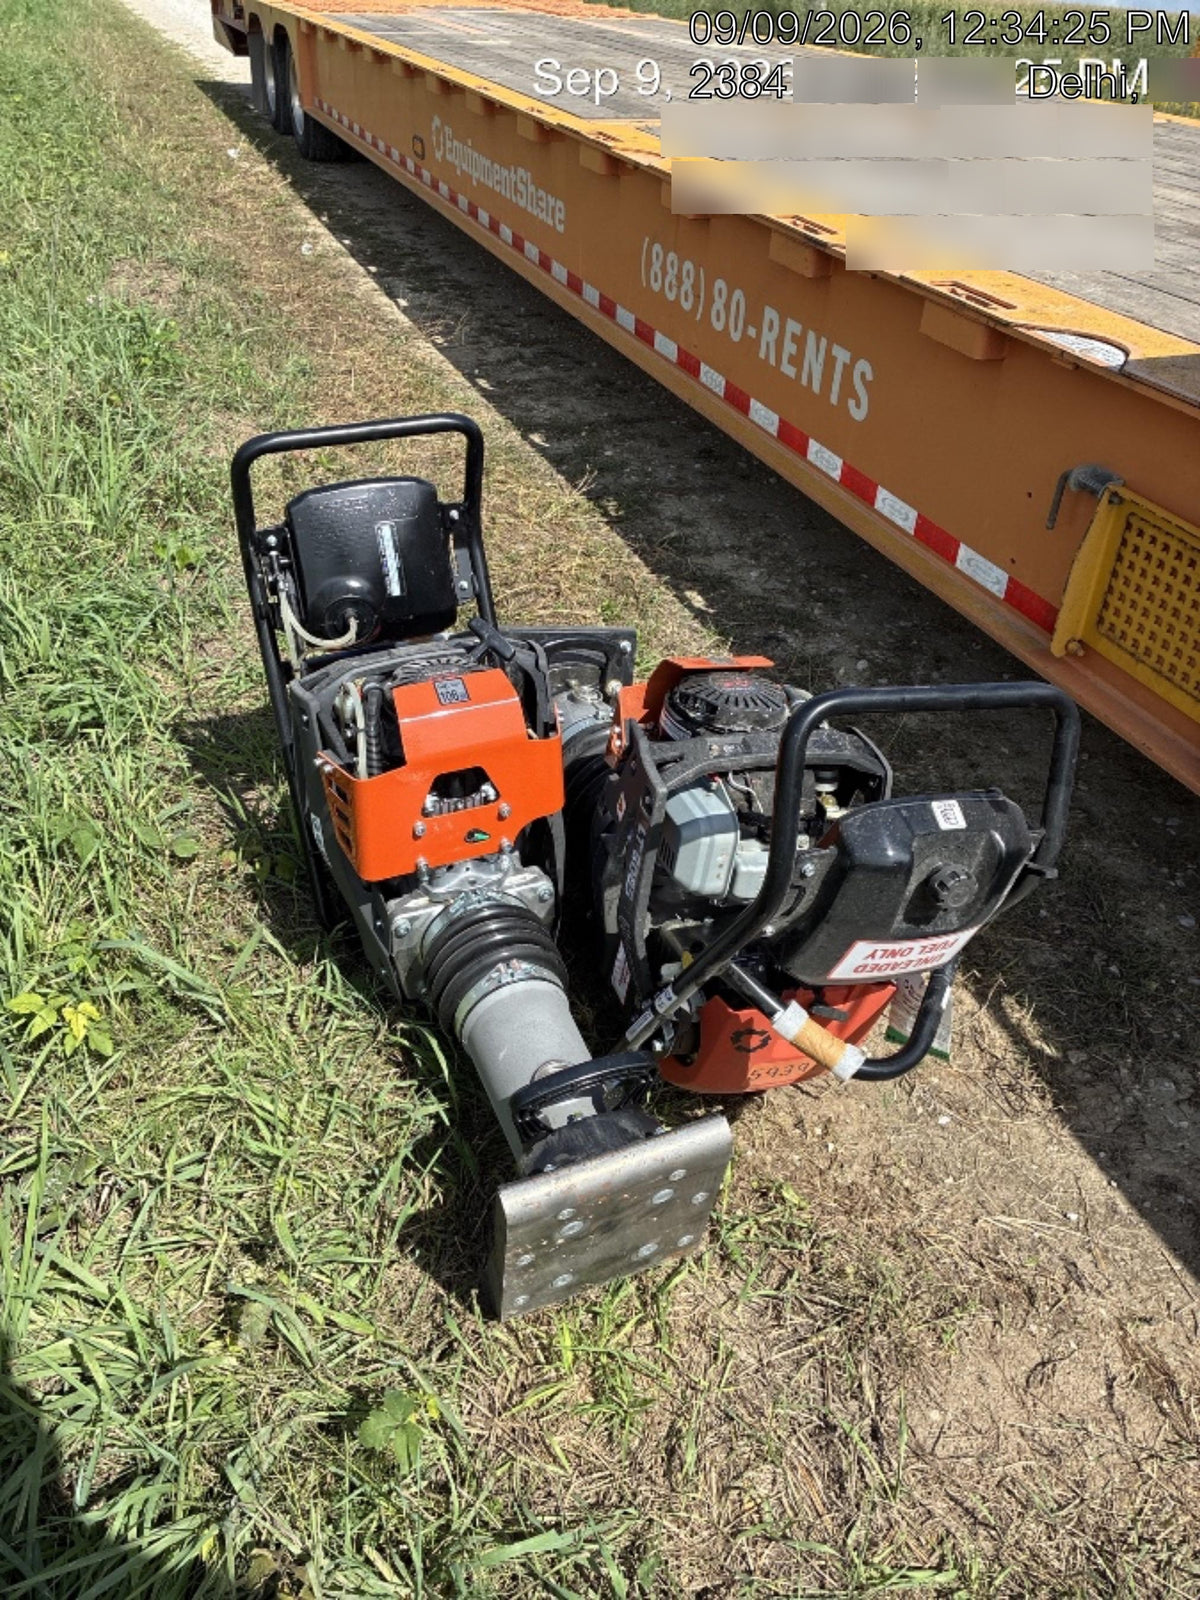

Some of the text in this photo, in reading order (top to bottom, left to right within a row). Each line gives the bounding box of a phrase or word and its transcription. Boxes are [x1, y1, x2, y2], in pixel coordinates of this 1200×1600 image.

[443, 125, 566, 234] EquipmentShare
[863, 936, 961, 961] FUEL ONLY
[852, 952, 946, 974] UNLEADED
